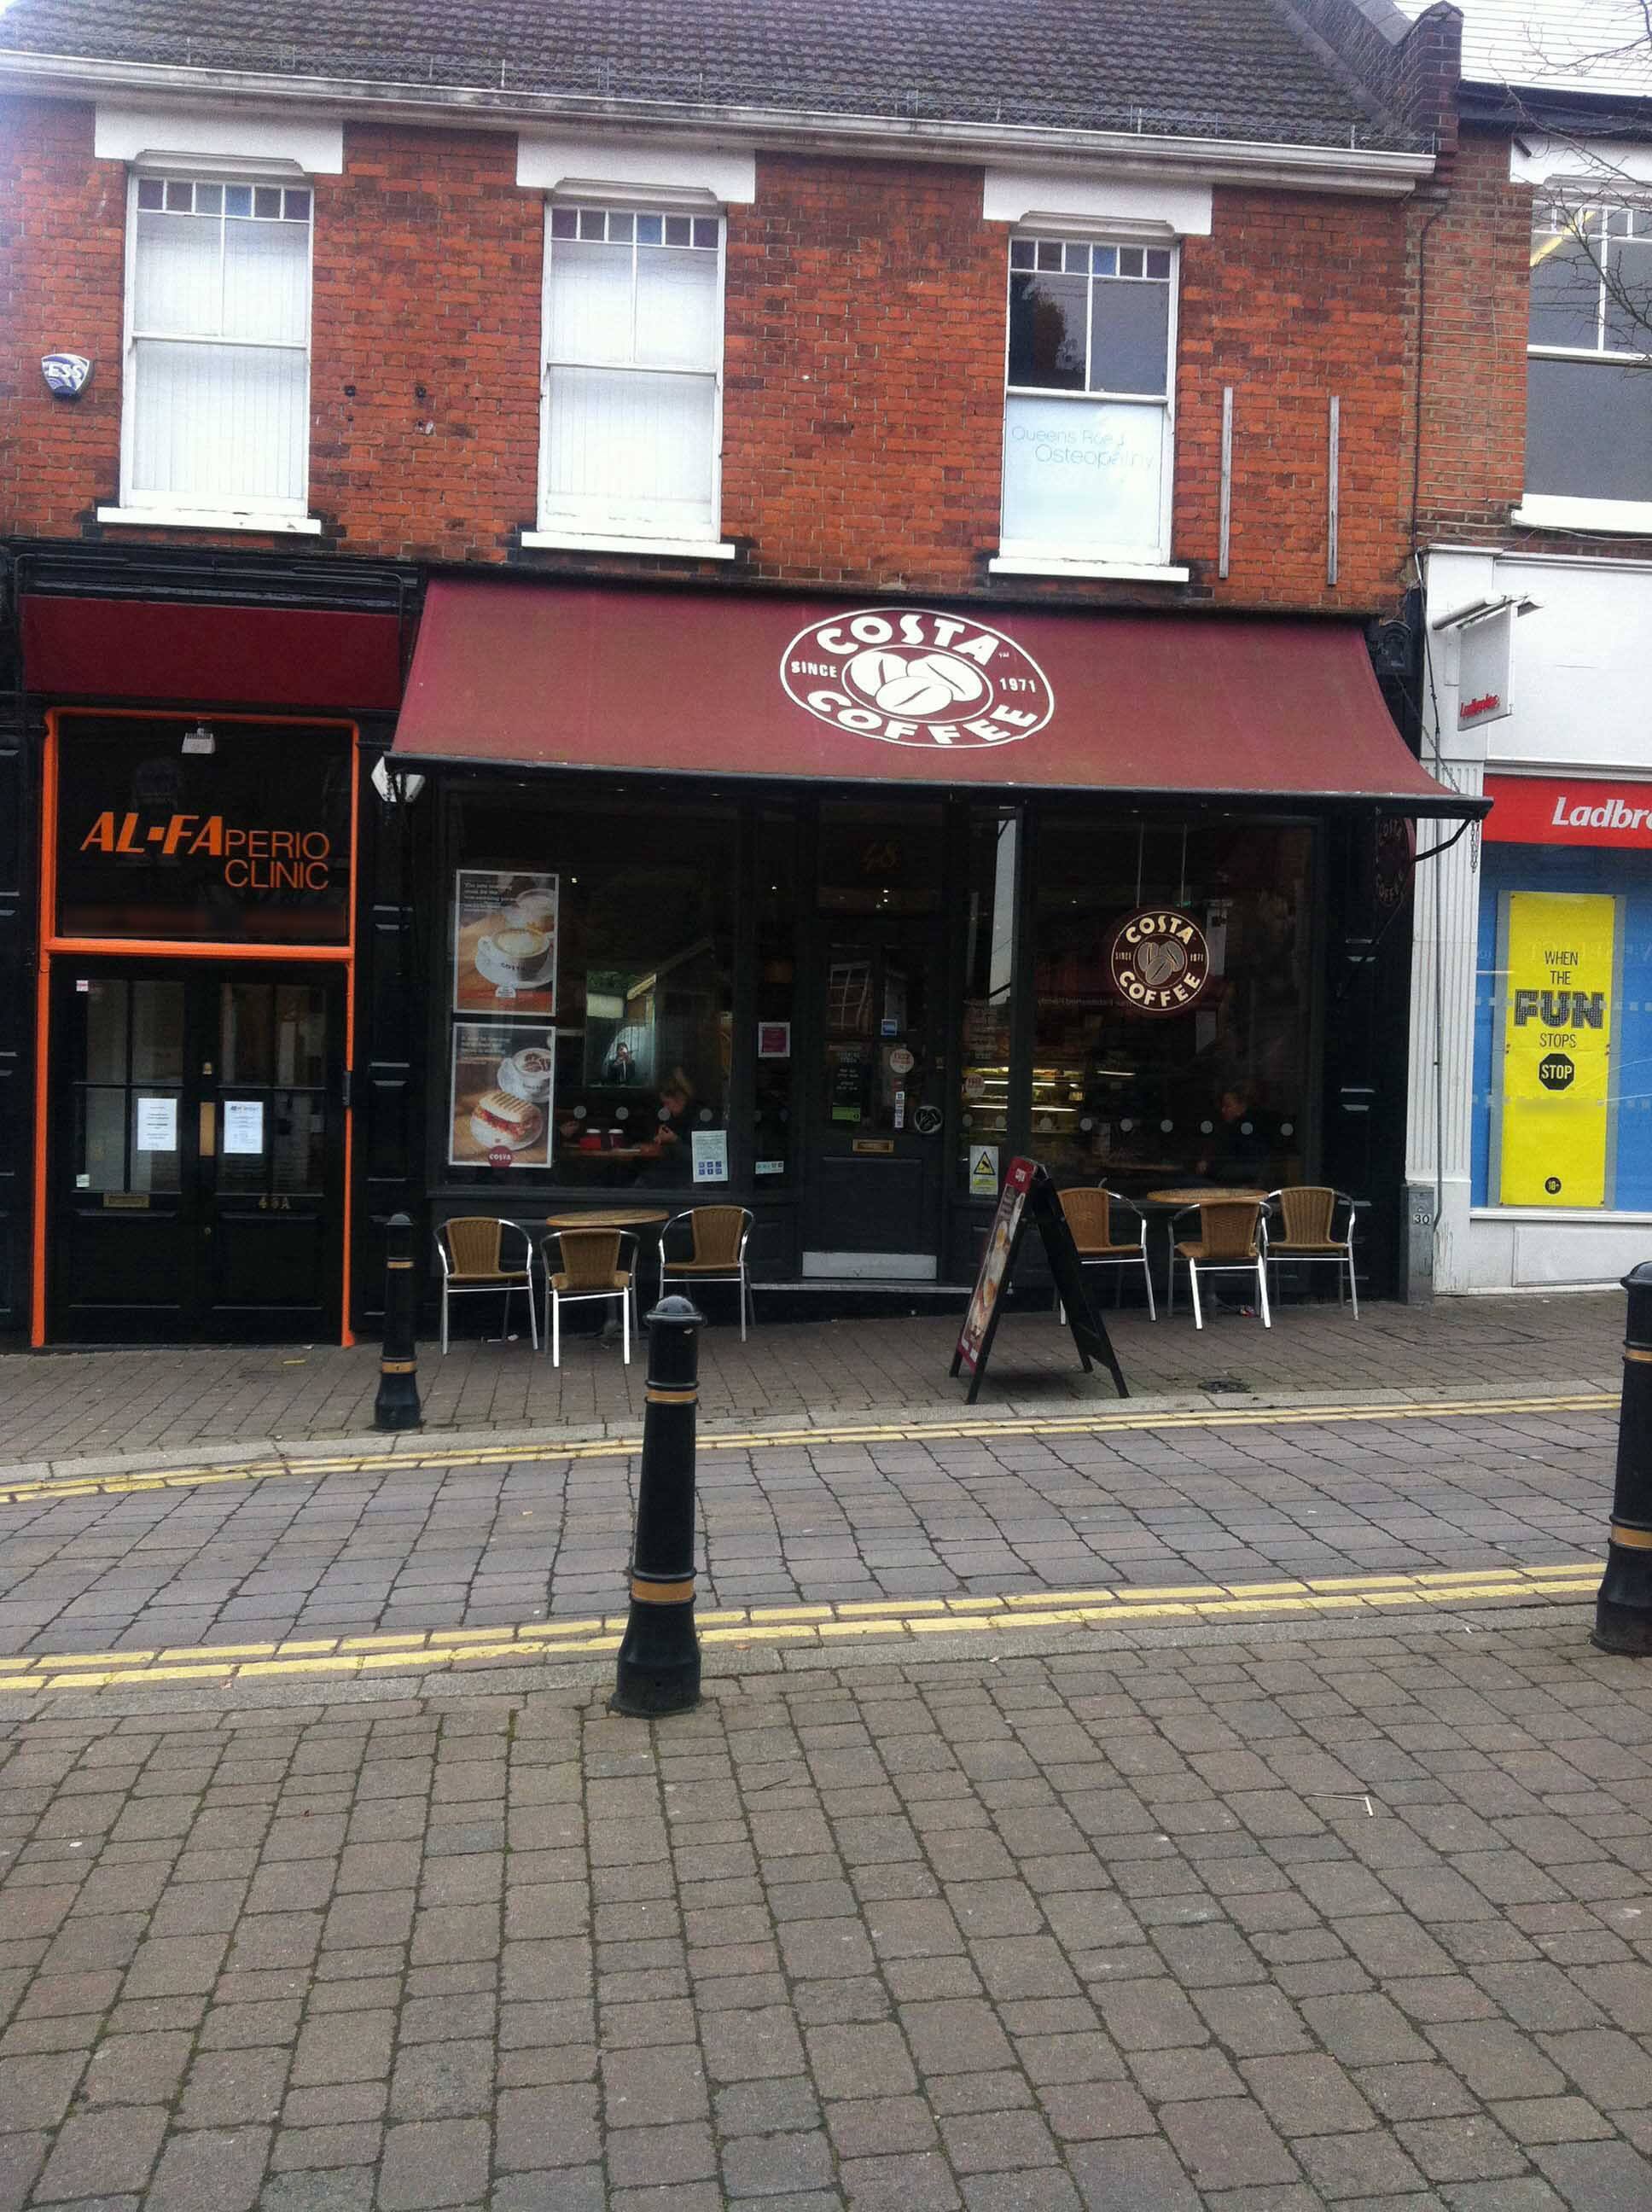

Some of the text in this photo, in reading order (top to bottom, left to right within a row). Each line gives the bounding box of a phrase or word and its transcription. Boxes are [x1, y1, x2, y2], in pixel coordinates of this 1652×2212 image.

[48, 363, 83, 378] ESS
[1011, 426, 1077, 445] Queens
[817, 614, 999, 666] COSTA
[791, 661, 838, 678] SINCE
[999, 678, 1037, 693] 1971
[807, 690, 1038, 744] COFFEE
[225, 829, 330, 860] PERIO
[224, 859, 329, 890] CLINIC
[1126, 916, 1194, 945] COSTA
[1544, 951, 1578, 966] WHEN
[1550, 971, 1571, 985] THE
[1120, 971, 1201, 1007] COFFEE
[1514, 989, 1605, 1030] FUN
[1539, 1033, 1576, 1048] STOPS
[1541, 1064, 1573, 1080] STOP
